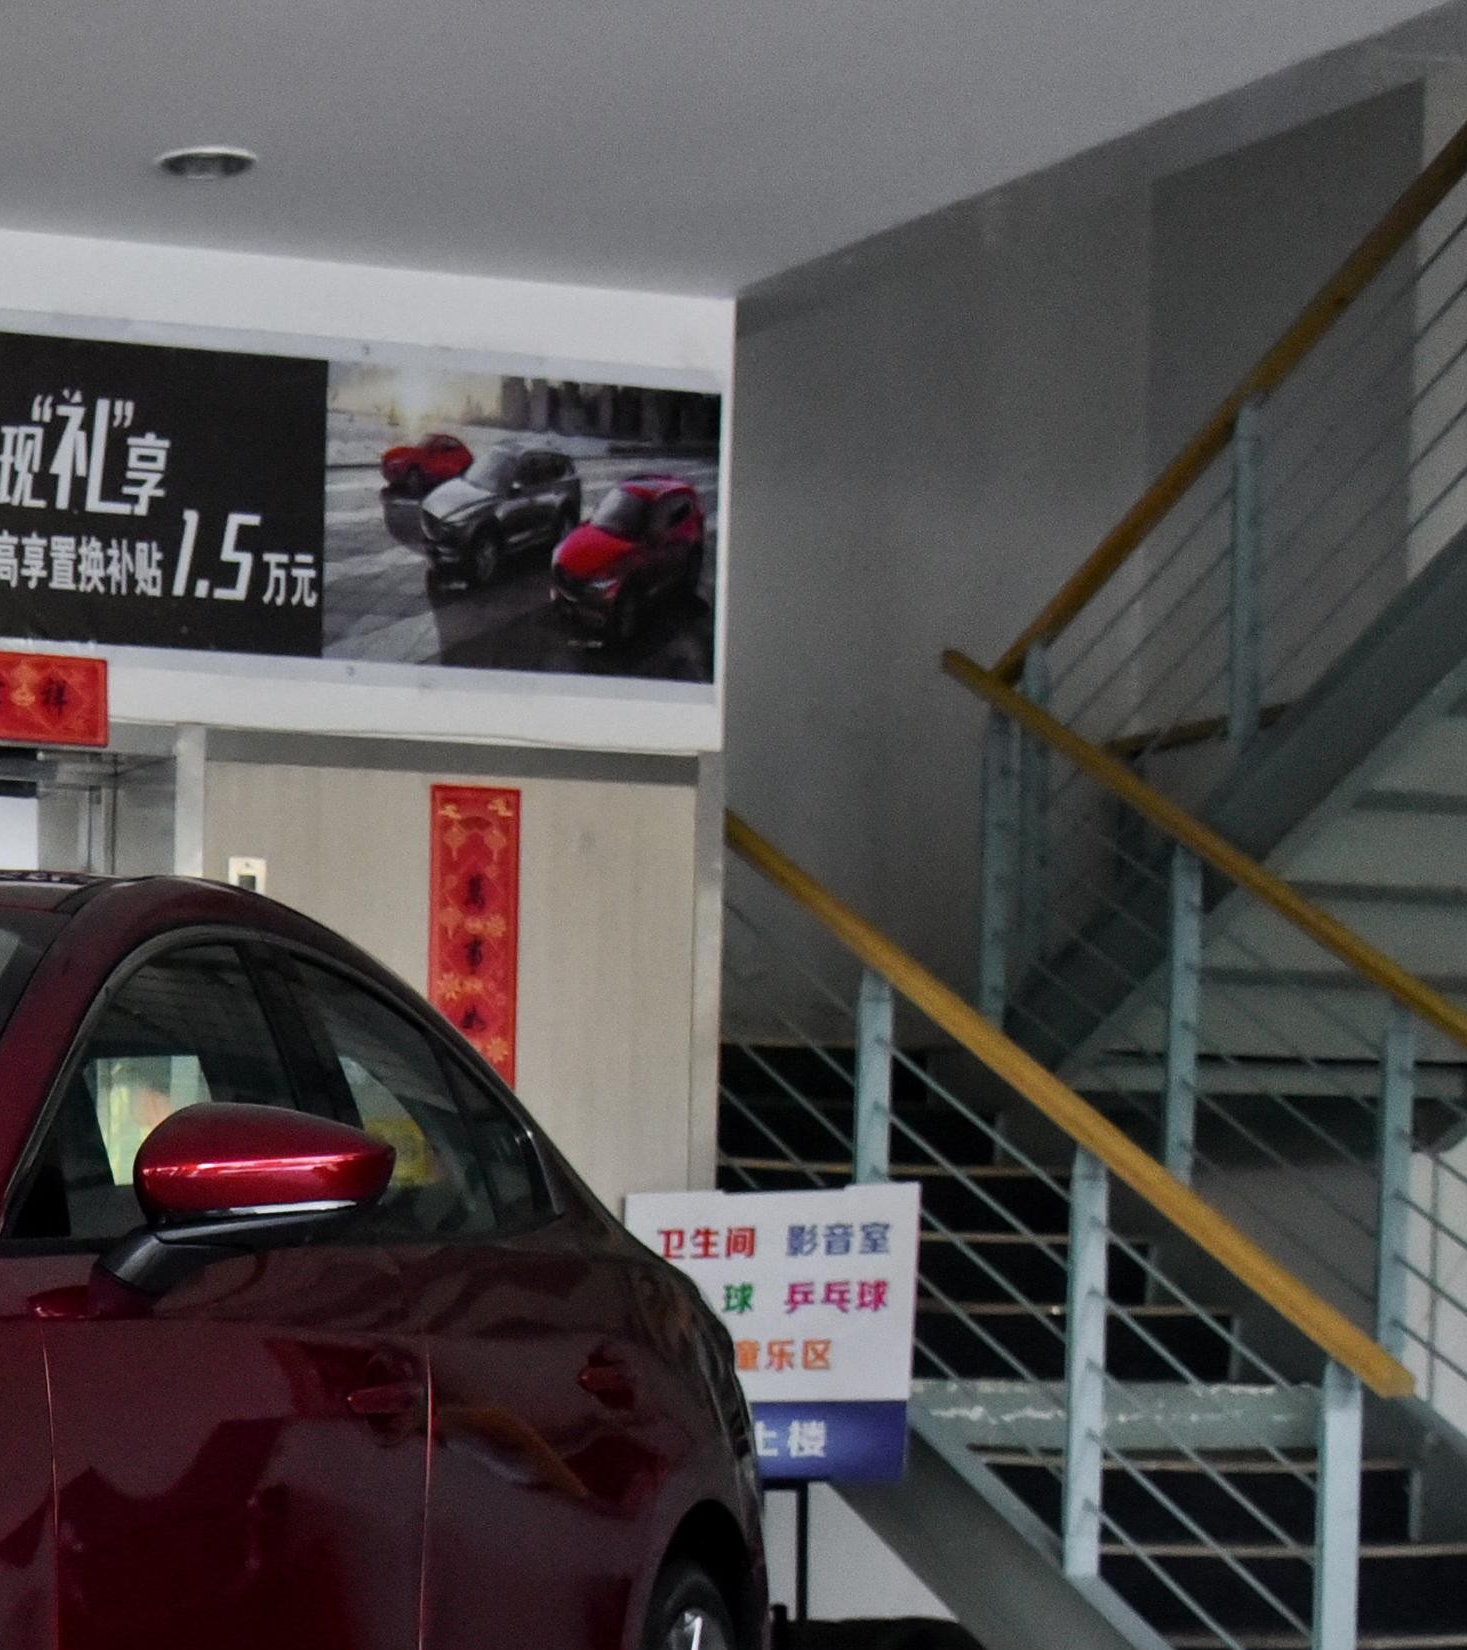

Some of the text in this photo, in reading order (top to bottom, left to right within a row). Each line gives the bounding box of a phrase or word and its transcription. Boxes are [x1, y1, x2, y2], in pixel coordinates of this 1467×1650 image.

[656, 1222, 891, 1260] 卫生间 影音室
[784, 1279, 889, 1314] 乒乓球
